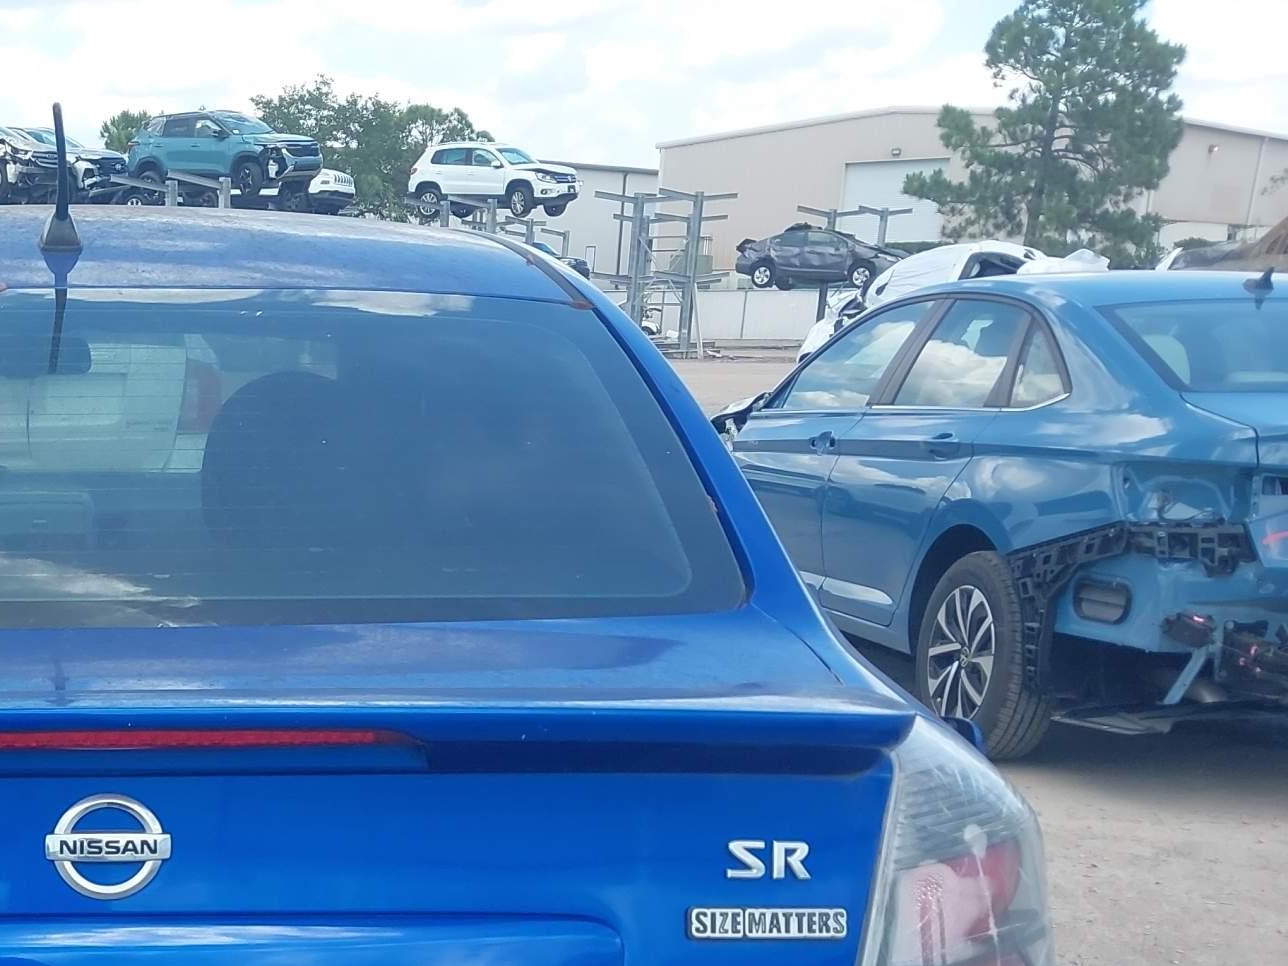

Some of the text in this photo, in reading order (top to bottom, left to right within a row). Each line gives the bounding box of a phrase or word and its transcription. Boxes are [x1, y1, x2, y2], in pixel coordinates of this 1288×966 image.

[59, 839, 158, 855] NISSAN
[726, 840, 812, 880] SR
[694, 910, 846, 935] SIZE MATTERS
